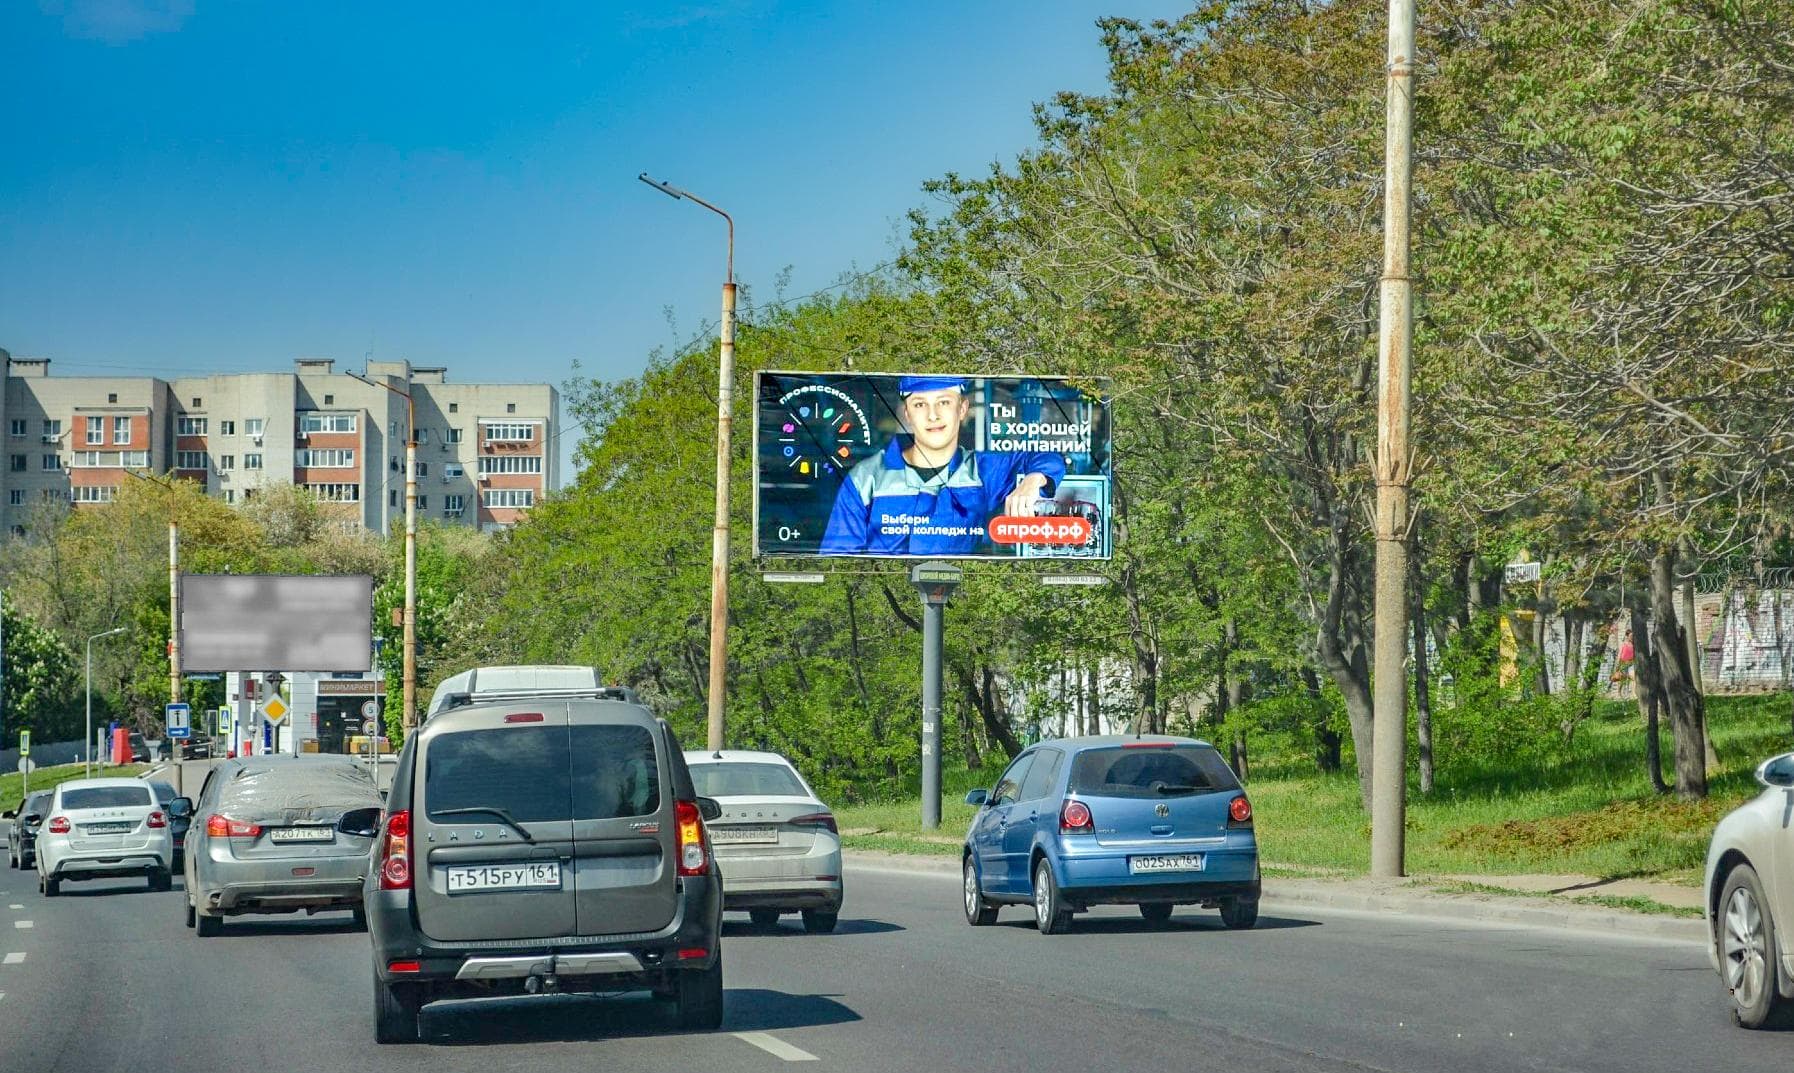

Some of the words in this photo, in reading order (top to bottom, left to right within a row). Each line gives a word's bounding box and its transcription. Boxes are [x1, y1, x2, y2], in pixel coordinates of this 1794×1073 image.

[779, 385, 870, 446] ПРОФЕССИОНАЛИТЕТ
[990, 403, 1016, 418] Ты
[990, 422, 1001, 435] в
[1006, 420, 1091, 438] хорошей
[991, 438, 1091, 452] компании!
[881, 514, 929, 525] Выбери
[778, 526, 800, 541] 0+
[881, 525, 909, 534] свой
[913, 527, 966, 536] колледж
[970, 527, 984, 535] на
[997, 521, 1083, 539] япроф.рф
[368, 706, 374, 714] 5
[428, 828, 508, 842] LADA
